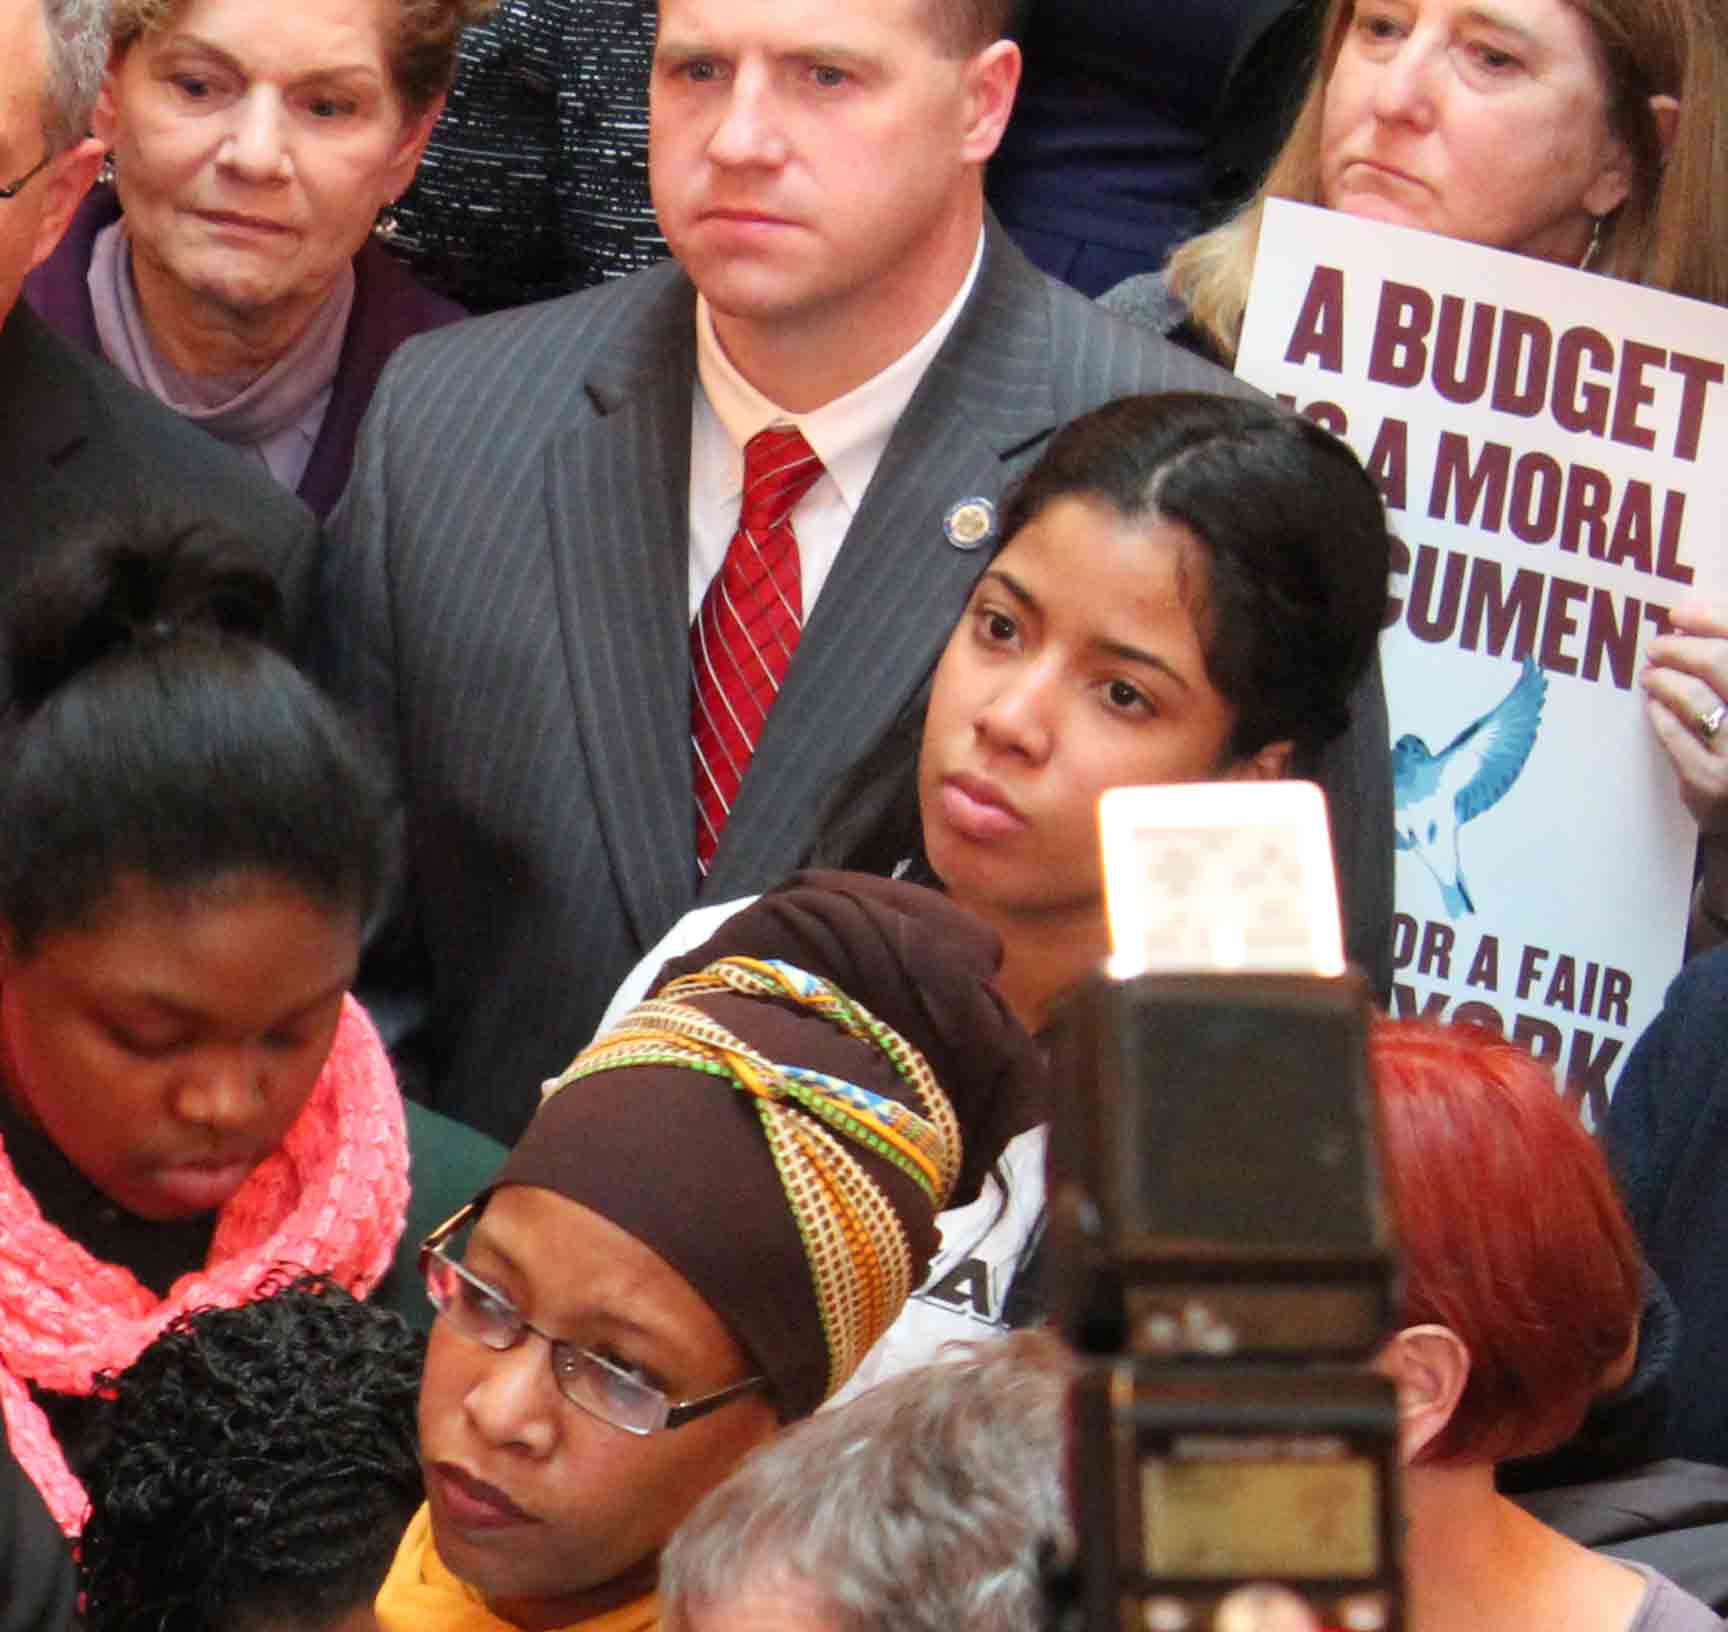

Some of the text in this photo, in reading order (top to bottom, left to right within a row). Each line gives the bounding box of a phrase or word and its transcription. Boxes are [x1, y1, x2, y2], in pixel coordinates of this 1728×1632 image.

[1283, 264, 1726, 463] A BUDGET
[1427, 429, 1696, 586] MORAL
[1465, 933, 1499, 992] A
[1515, 944, 1634, 1028] FAIR
